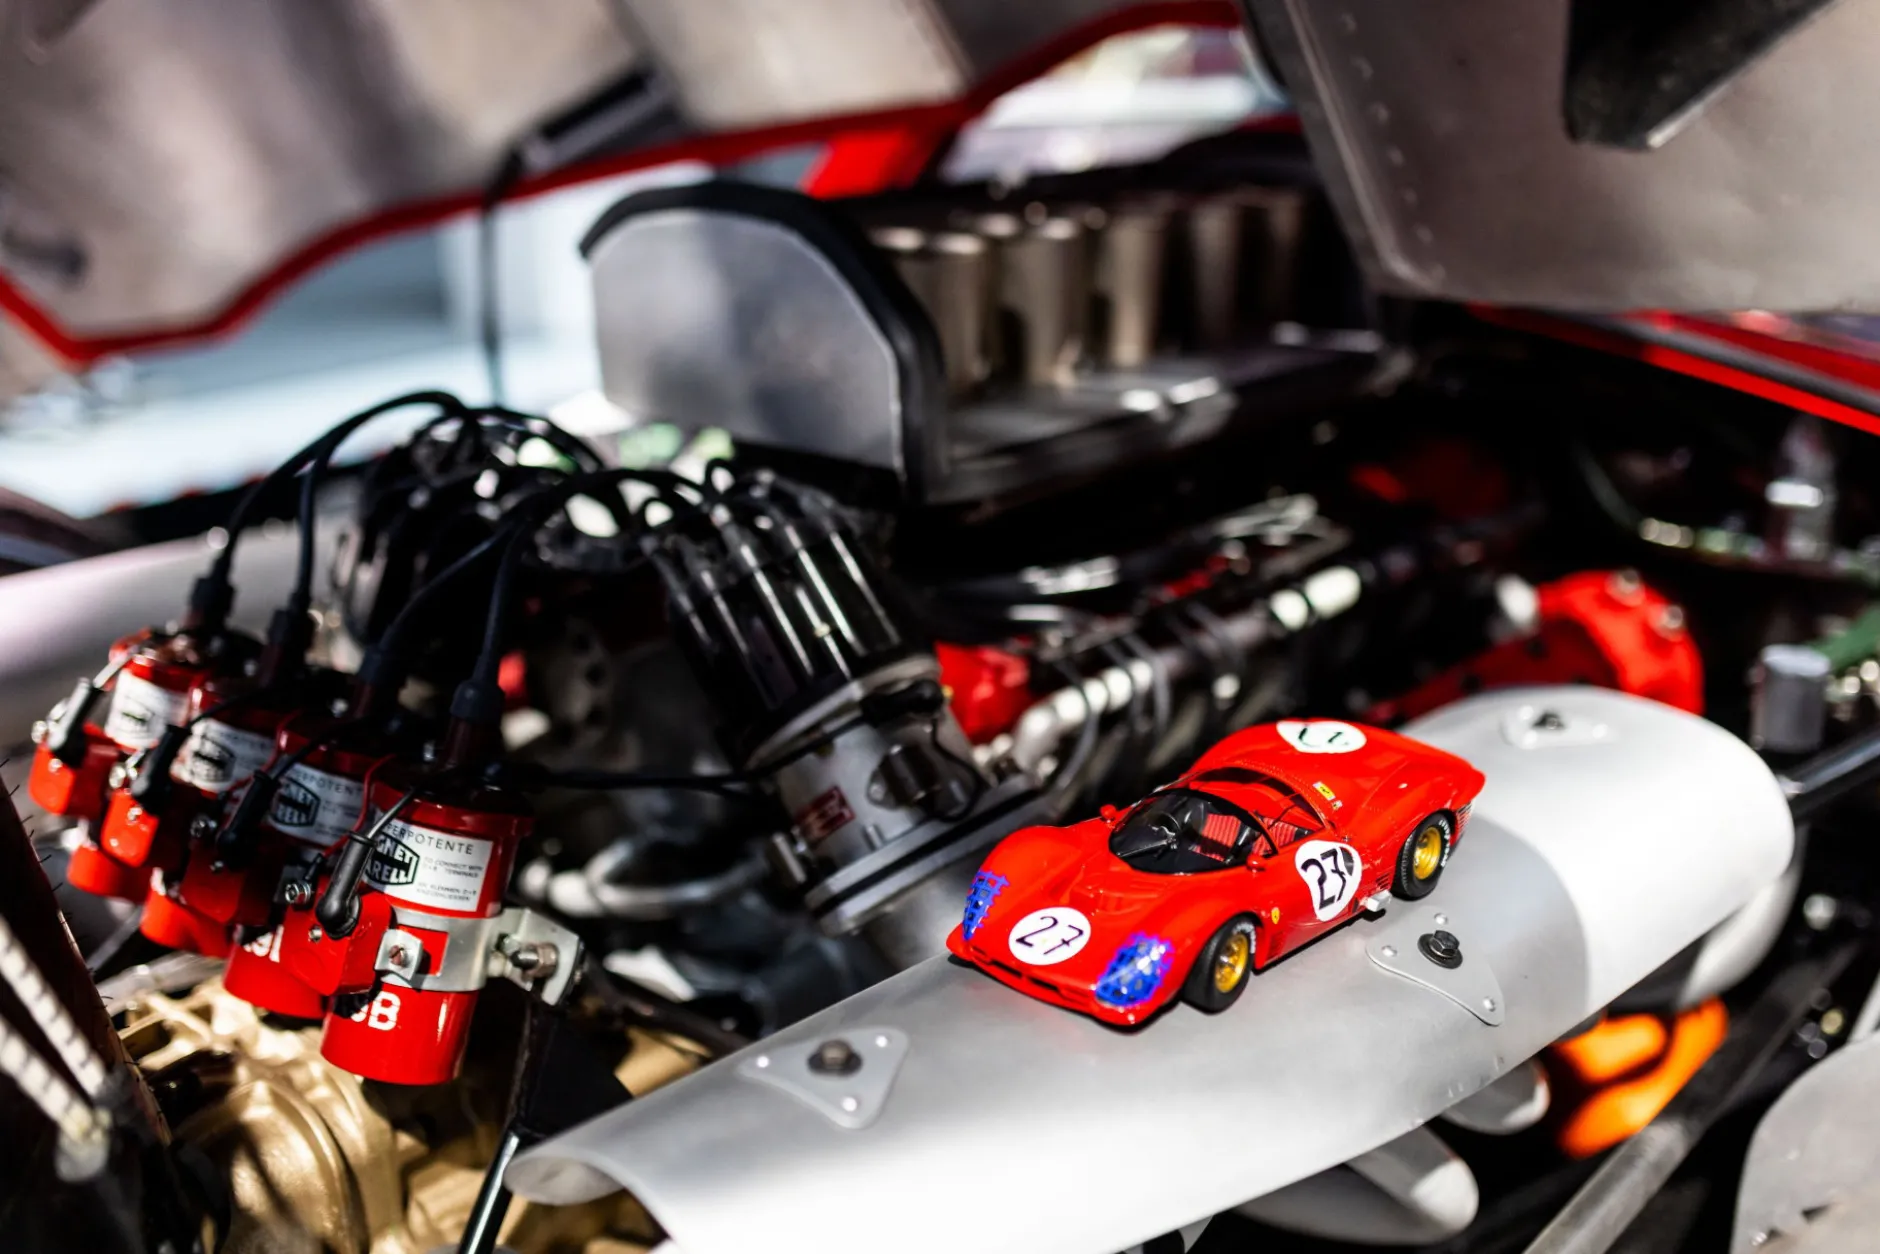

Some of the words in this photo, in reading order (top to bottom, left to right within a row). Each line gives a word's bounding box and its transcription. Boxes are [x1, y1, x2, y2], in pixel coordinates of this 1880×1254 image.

[386, 822, 474, 855] PERPOTENTE
[365, 857, 417, 884] ARELLI
[1300, 847, 1347, 911] 27
[1015, 915, 1084, 956] 27
